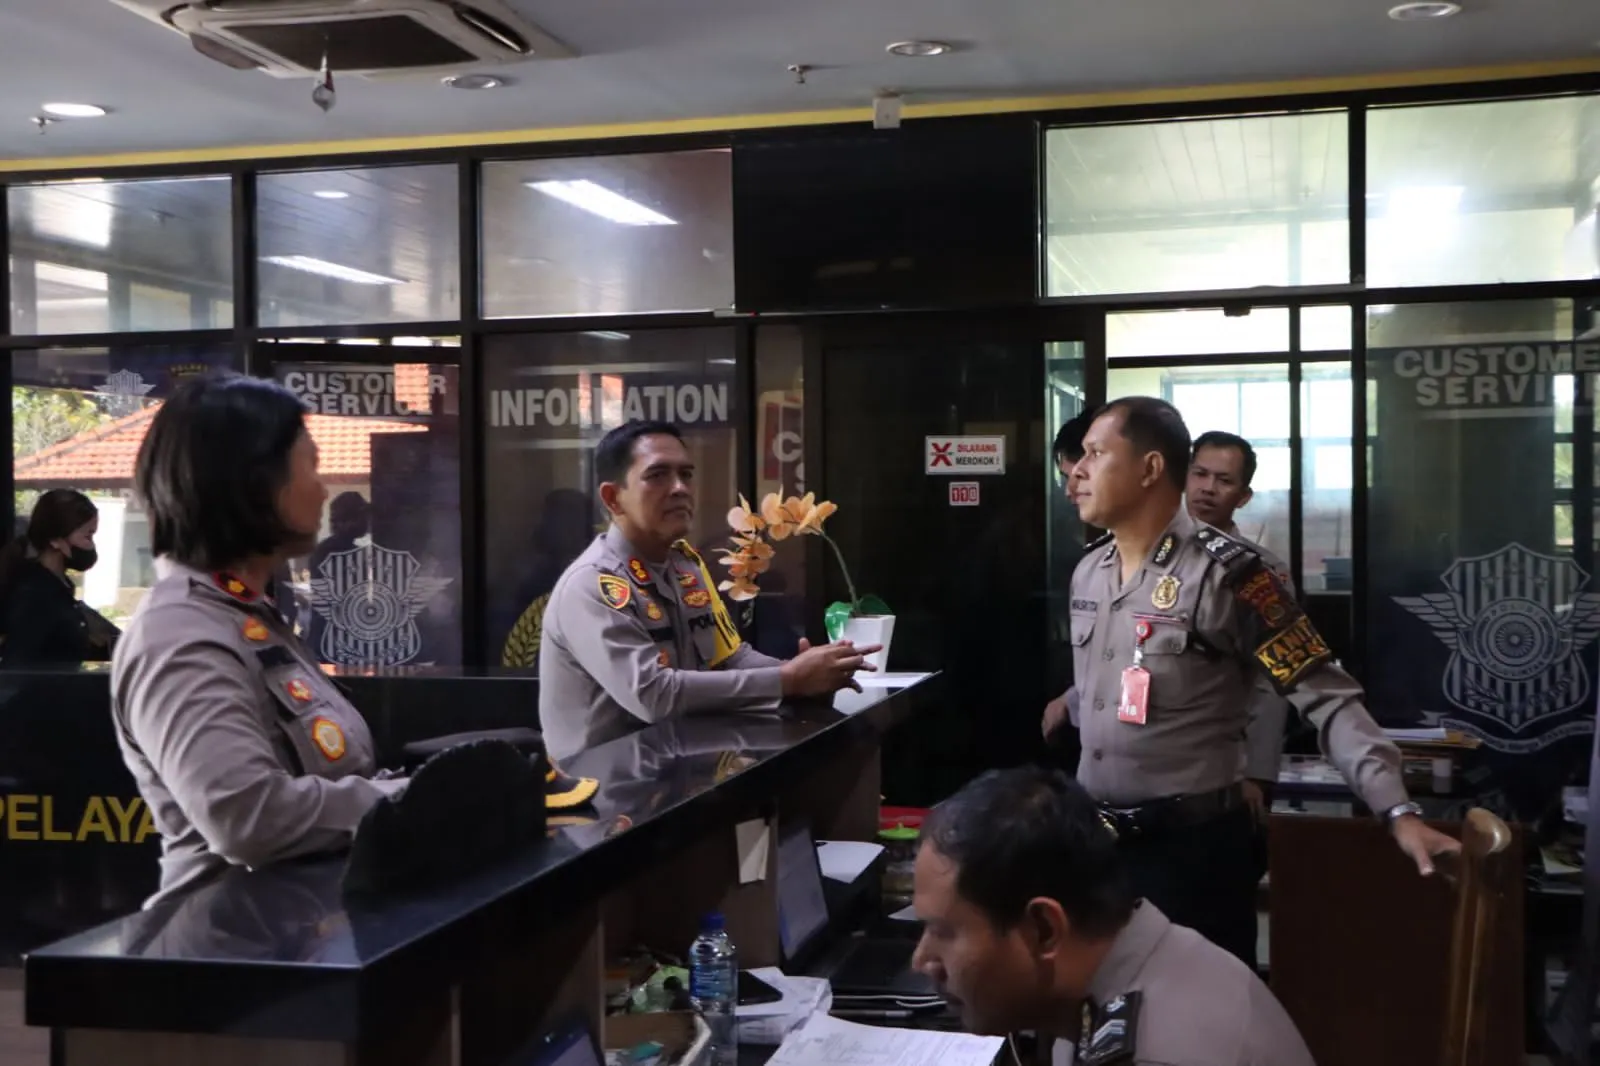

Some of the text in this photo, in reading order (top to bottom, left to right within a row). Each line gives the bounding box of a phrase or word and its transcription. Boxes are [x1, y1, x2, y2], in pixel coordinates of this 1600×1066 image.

[284, 371, 447, 394] CUSTOR
[1416, 374, 1599, 406] SERVI
[300, 393, 433, 416] SERVIC
[956, 456, 994, 466] MEROKOK
[0, 795, 159, 843] ELAYA
